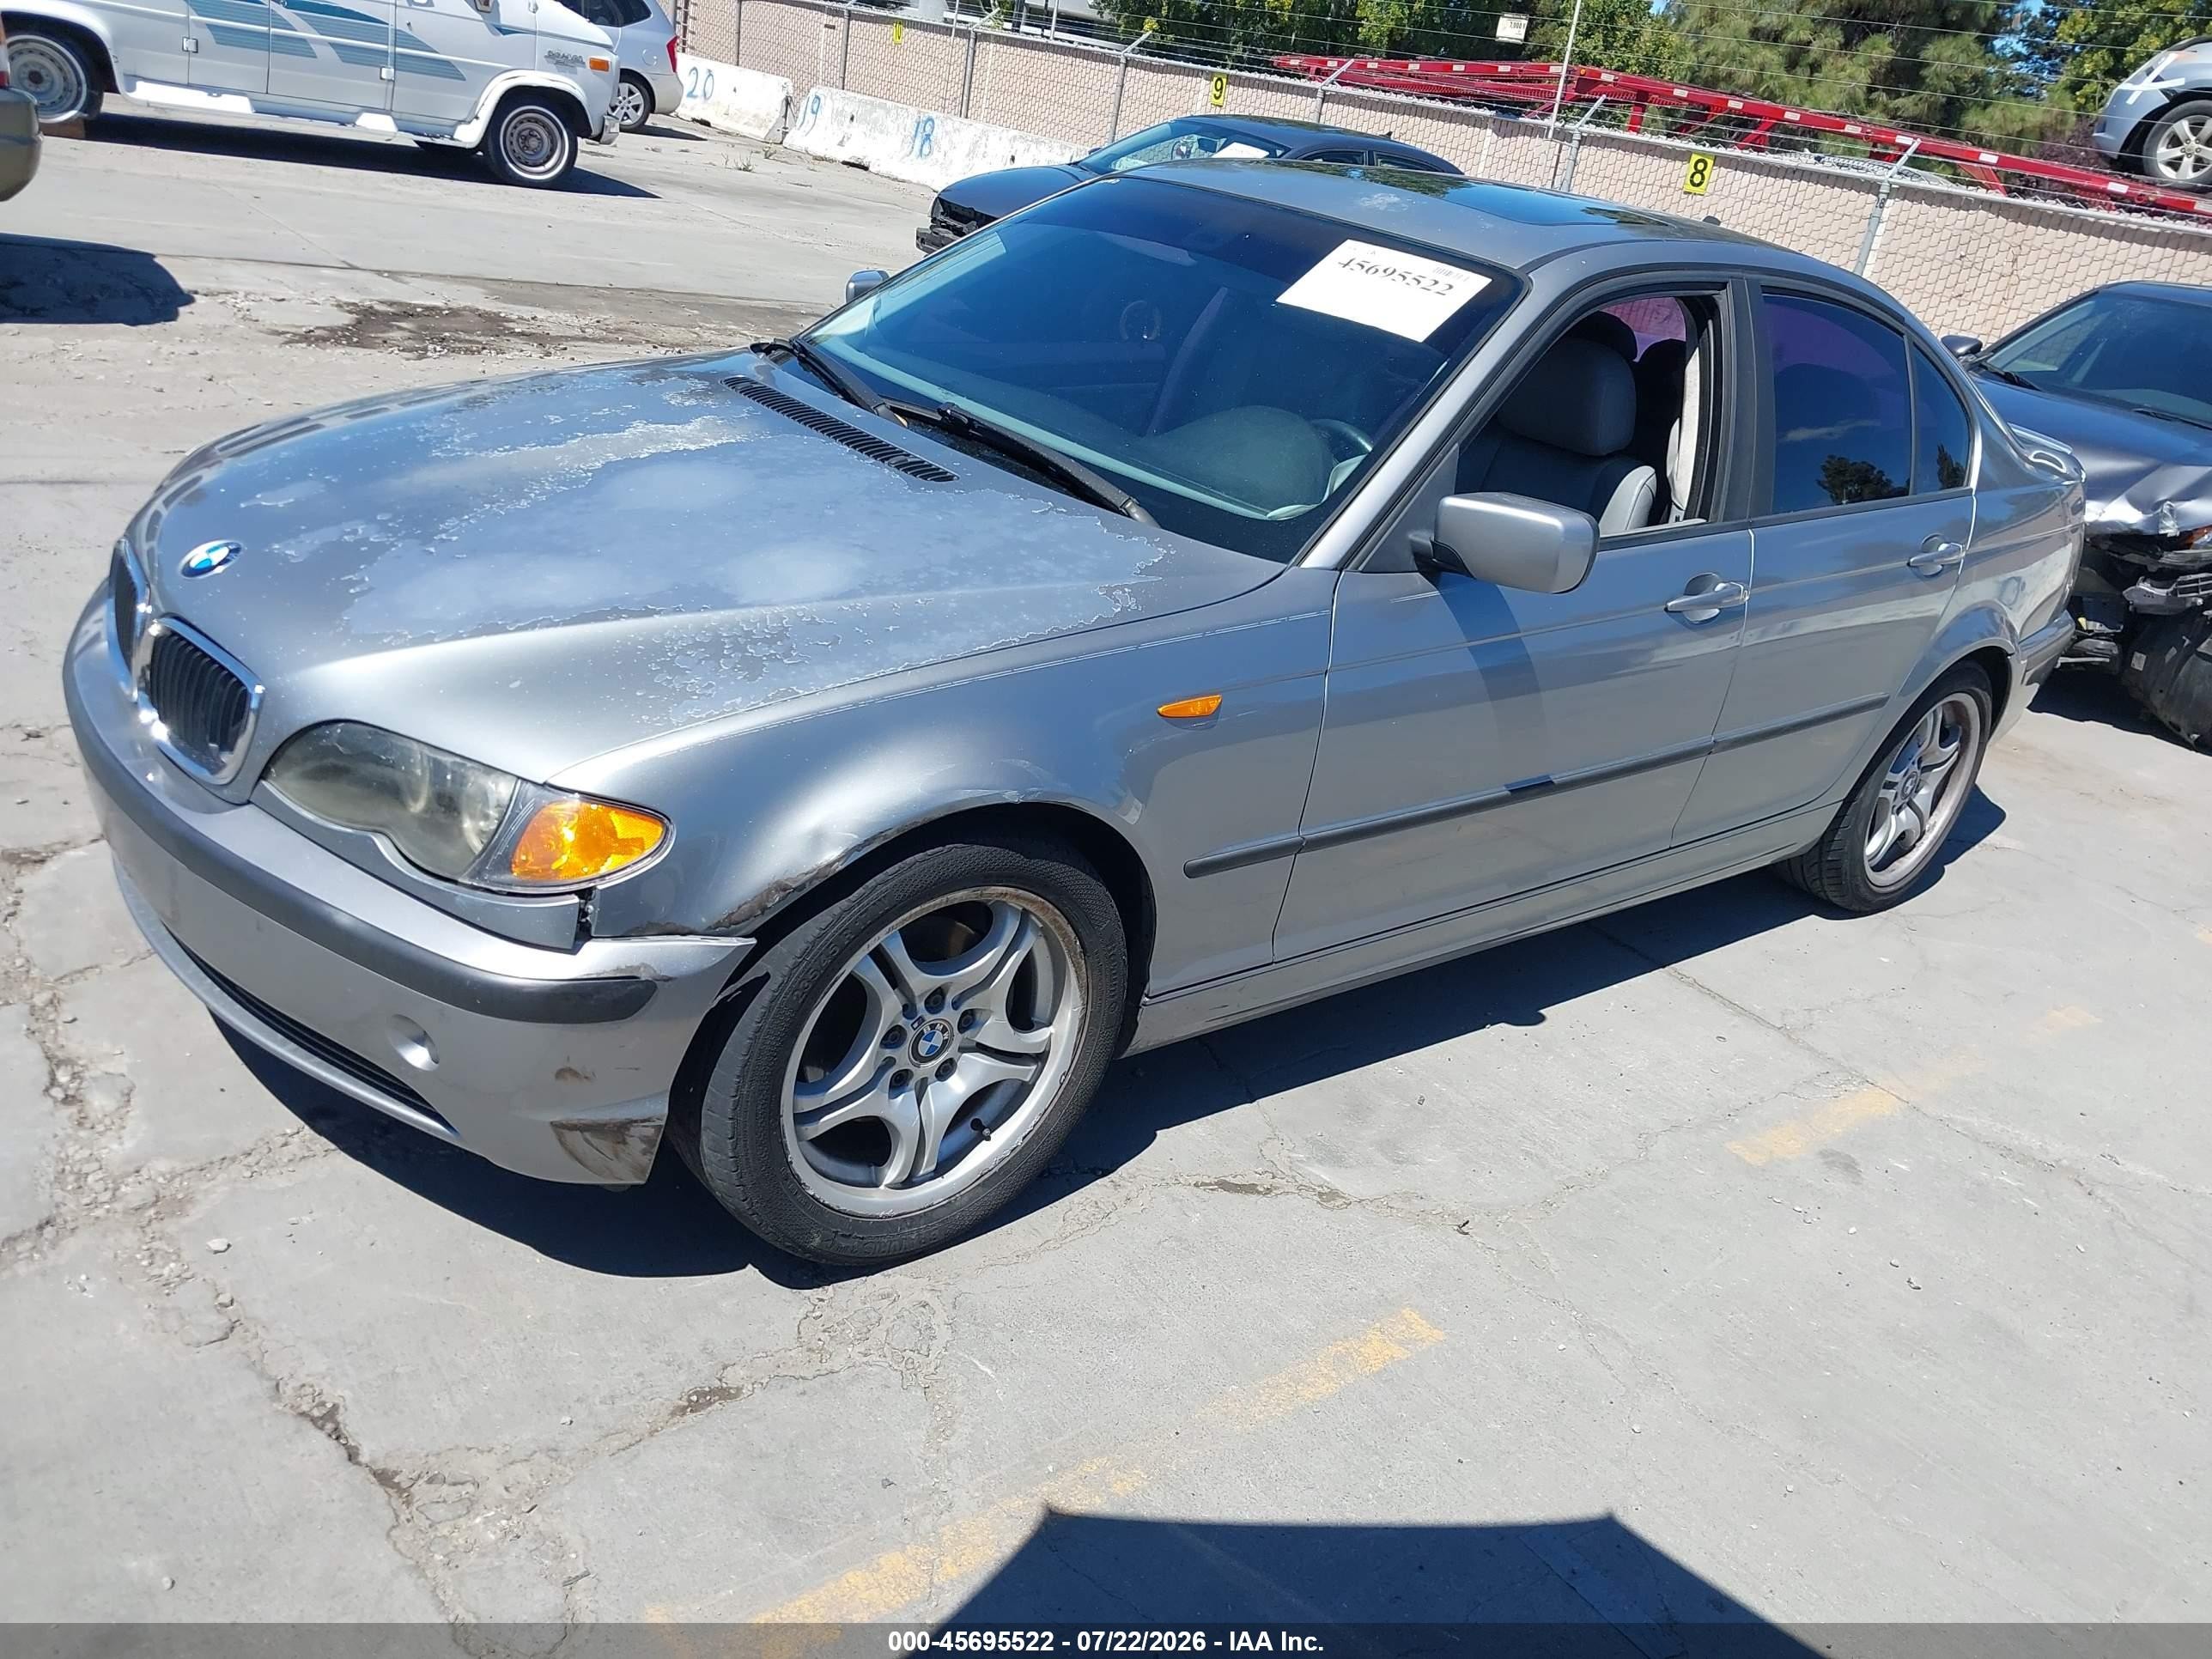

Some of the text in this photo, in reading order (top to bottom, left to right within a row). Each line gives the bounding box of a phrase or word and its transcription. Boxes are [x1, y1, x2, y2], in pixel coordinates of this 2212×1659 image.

[686, 66, 714, 101] 20
[1213, 77, 1224, 100] 9
[798, 94, 821, 137] 19
[907, 115, 935, 159] 18
[1689, 158, 1709, 187] 8
[1337, 257, 1455, 295] 45695522
[923, 1023, 949, 1041] BMW
